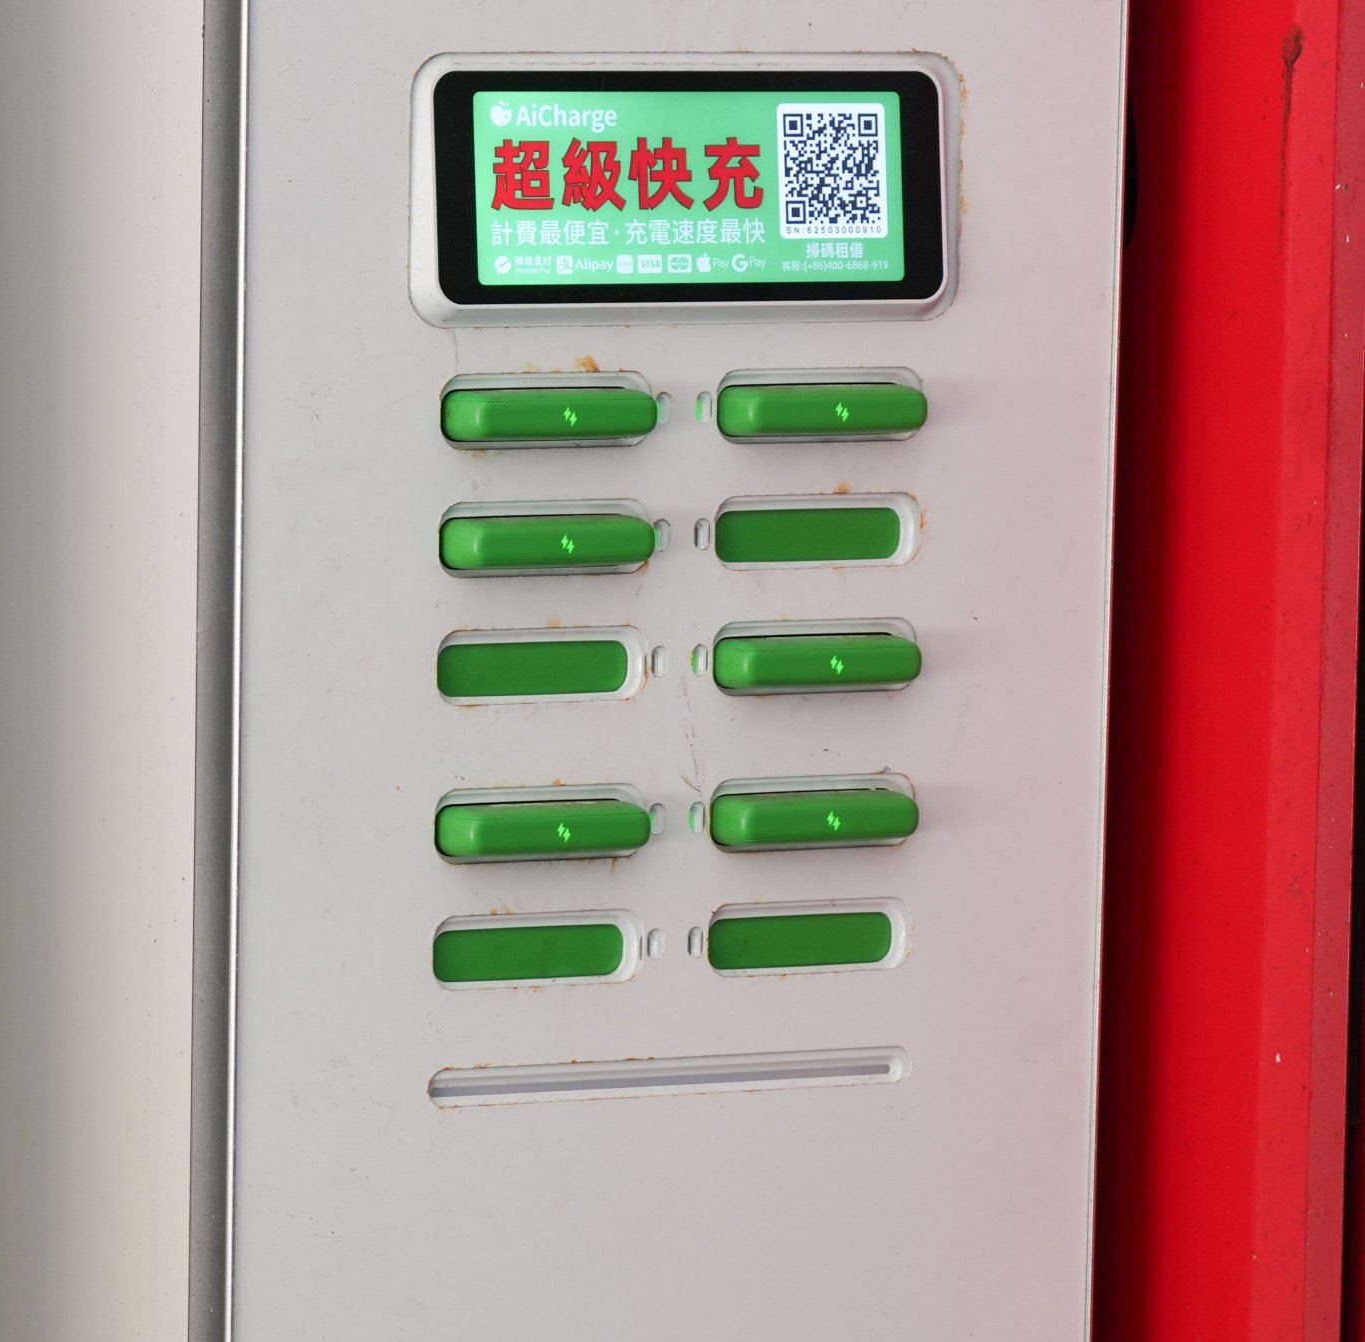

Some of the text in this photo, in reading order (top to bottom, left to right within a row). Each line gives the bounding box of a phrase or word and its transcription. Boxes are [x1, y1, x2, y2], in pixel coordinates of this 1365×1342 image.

[516, 104, 617, 133] AiCharge
[491, 136, 764, 212] 超級快充
[806, 242, 864, 259] 掃碼租借
[575, 258, 614, 273] Alipay
[640, 259, 661, 269] VISA
[712, 257, 729, 271] Pay
